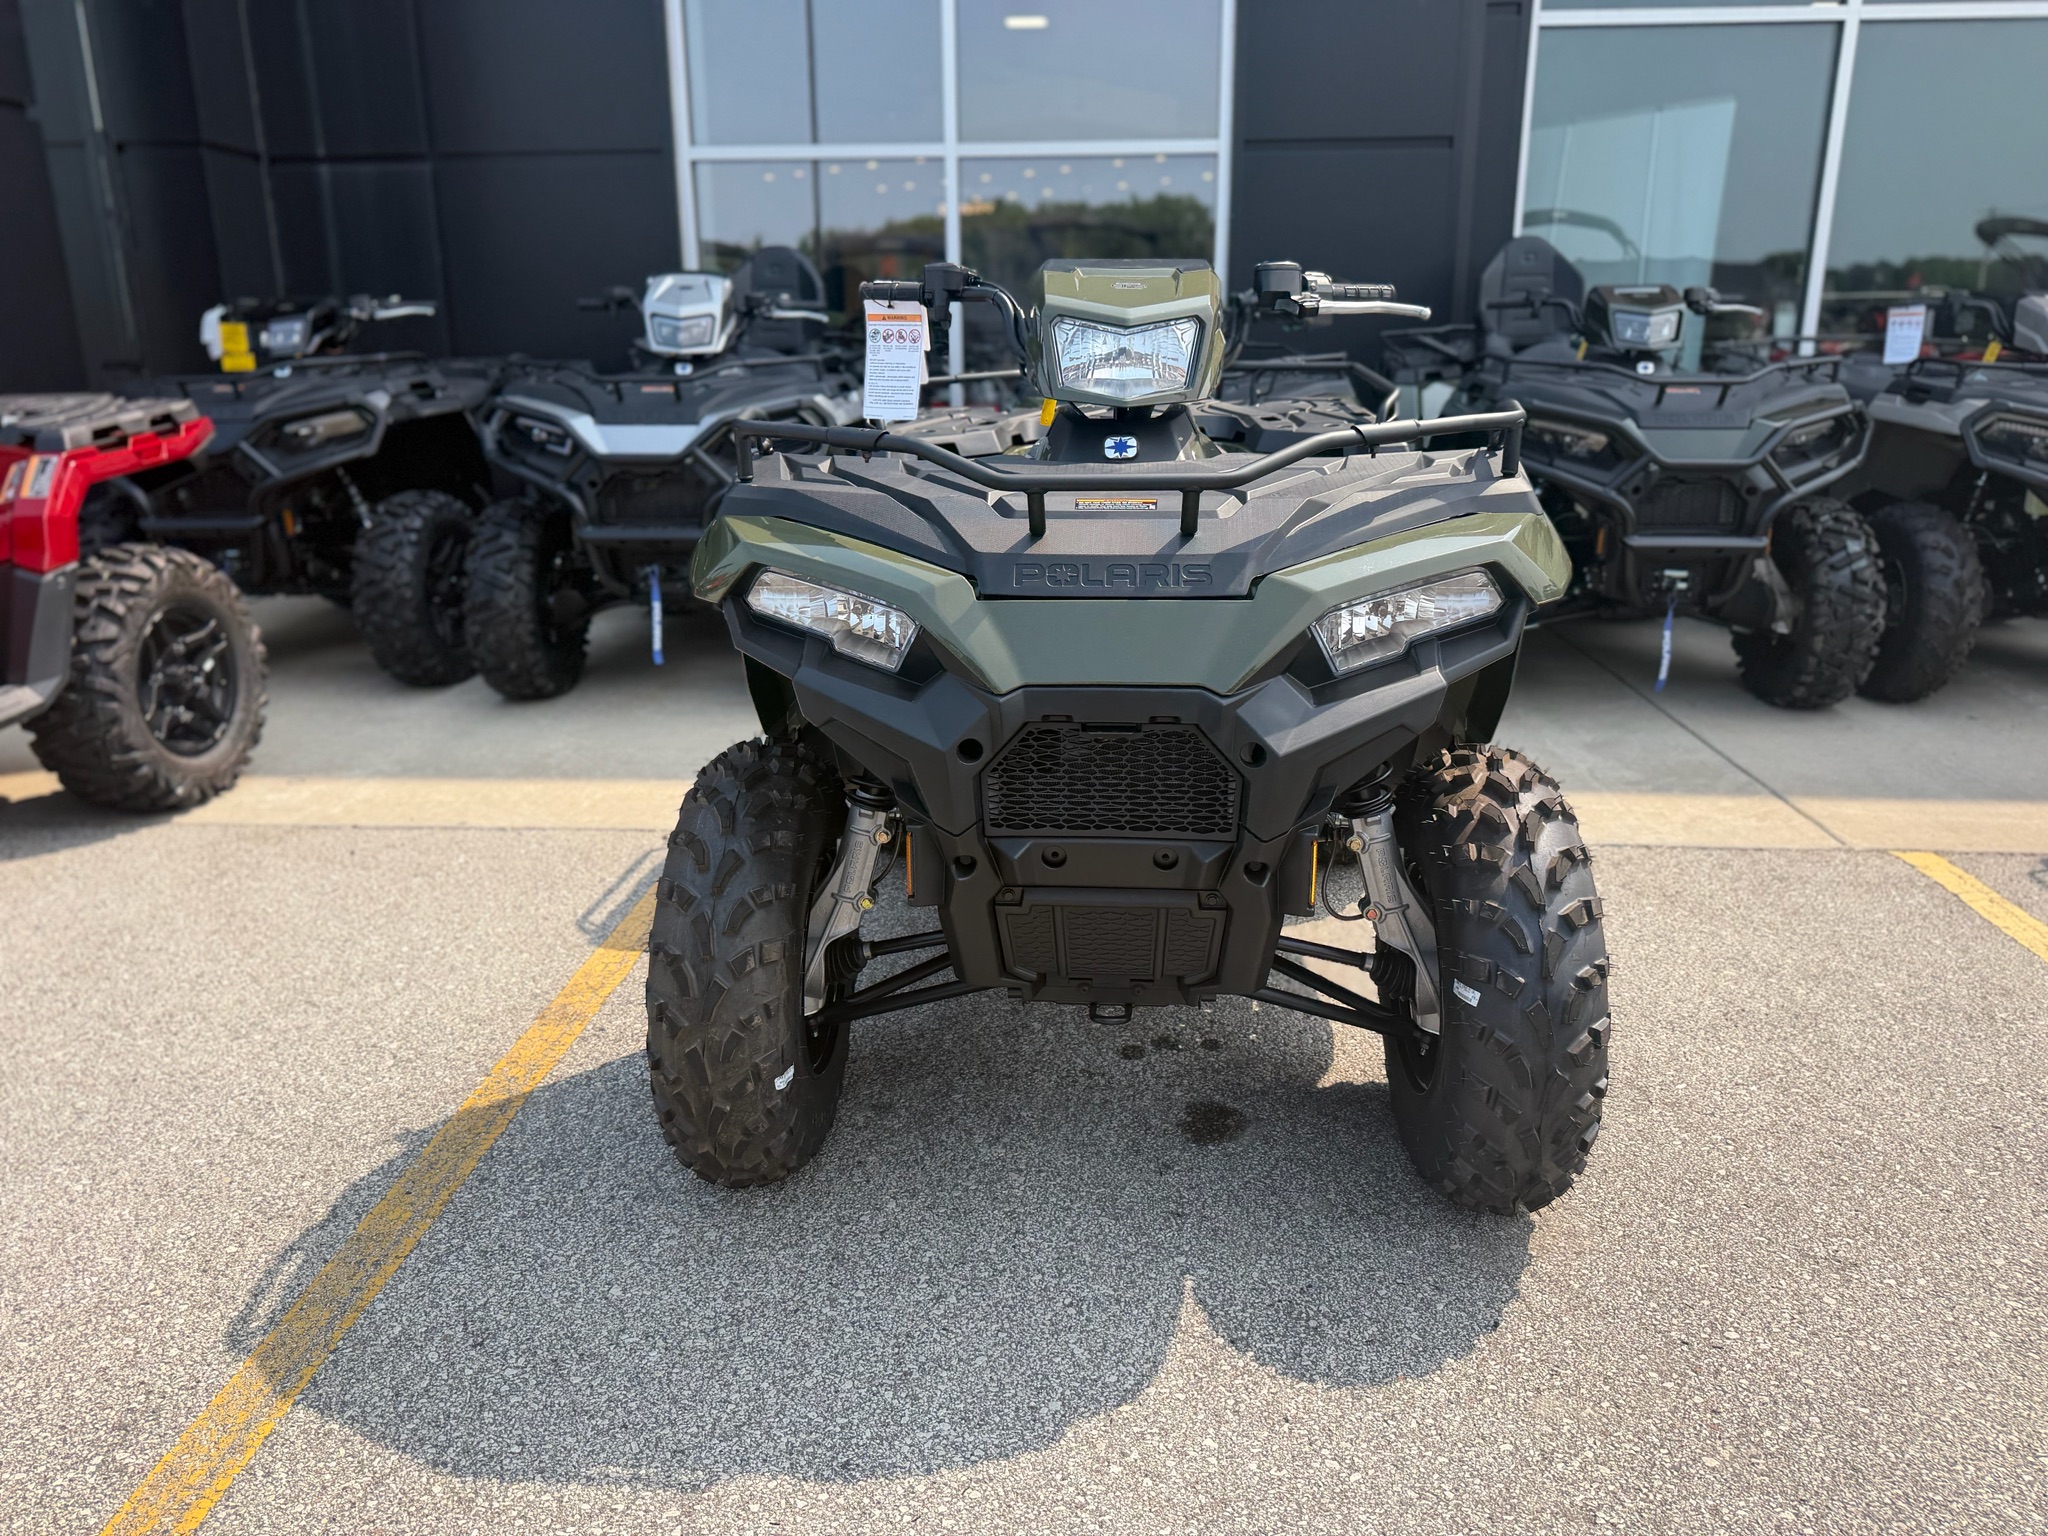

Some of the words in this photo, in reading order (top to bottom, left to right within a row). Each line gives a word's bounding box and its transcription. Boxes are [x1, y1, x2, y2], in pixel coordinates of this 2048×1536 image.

[1014, 563, 1213, 588] POLARIS
[844, 840, 864, 893] POLARIS
[1376, 847, 1396, 903] POLARIS
